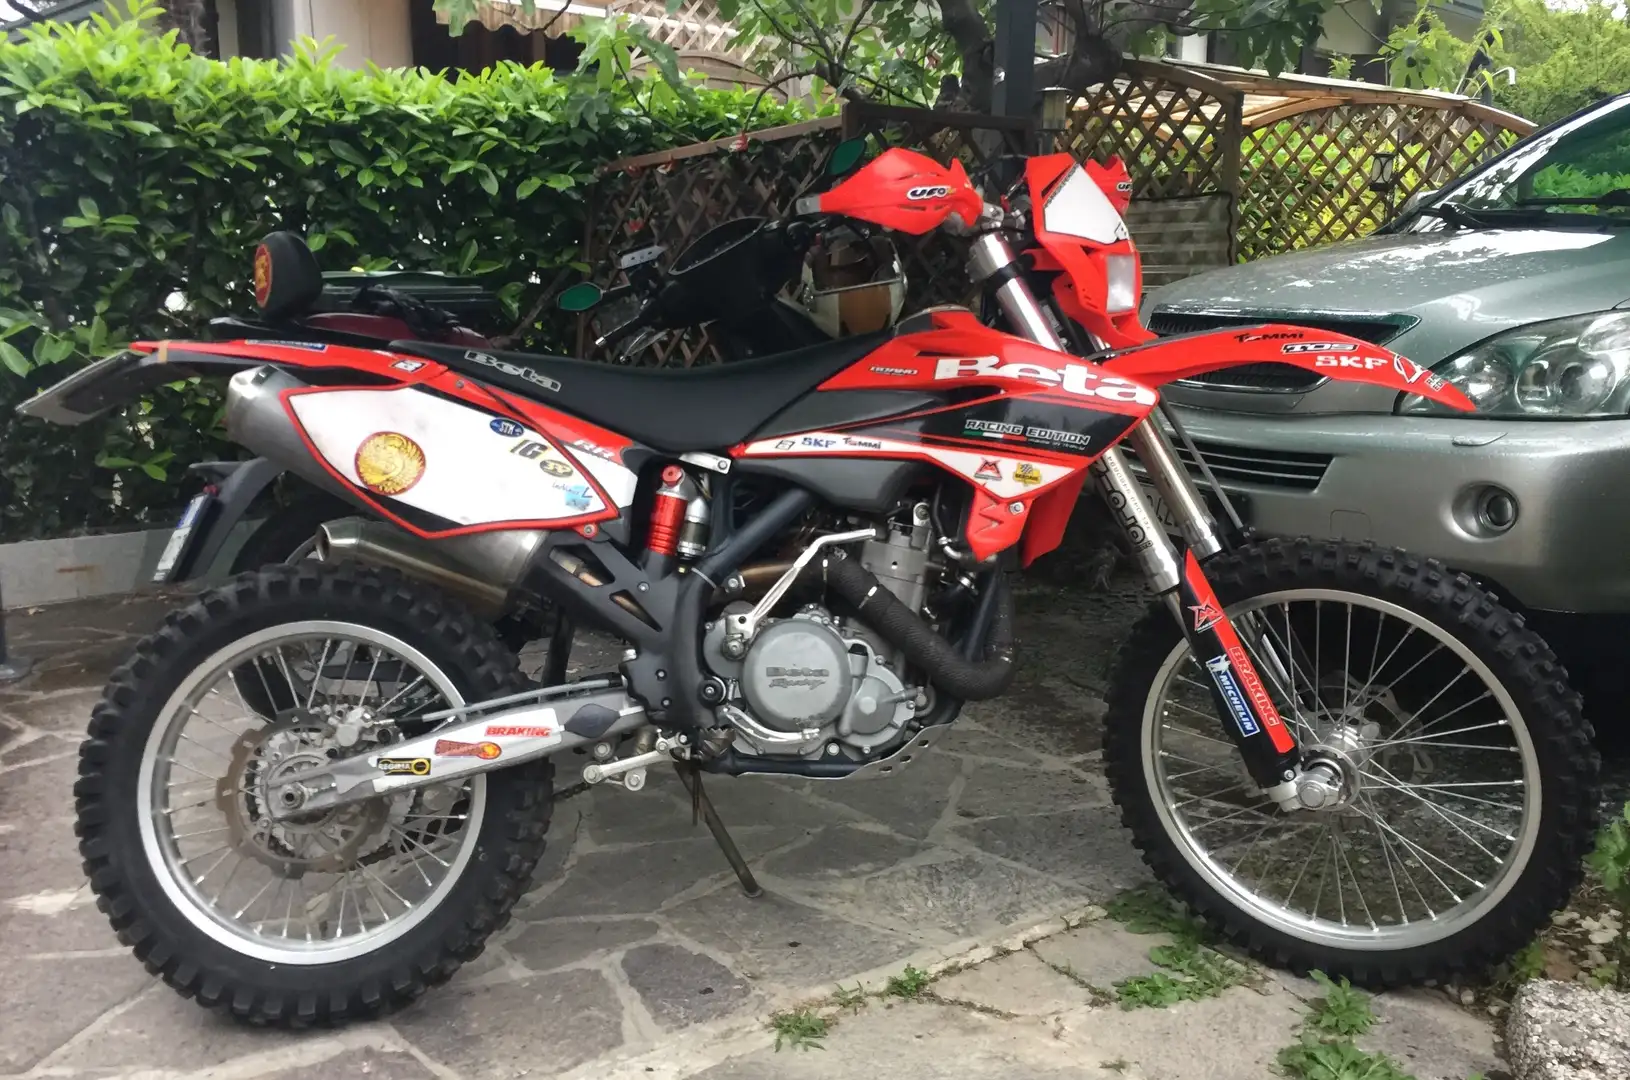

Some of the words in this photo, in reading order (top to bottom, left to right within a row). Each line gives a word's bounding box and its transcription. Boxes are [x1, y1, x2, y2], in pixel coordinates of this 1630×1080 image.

[907, 185, 949, 200] UFO
[1117, 182, 1133, 191] UF
[464, 350, 561, 392] Beta
[1316, 355, 1388, 369] SKF
[935, 355, 1157, 405] Beta
[802, 437, 836, 448] SKF
[965, 420, 1024, 435] RACING
[1026, 426, 1091, 446] EDITION
[1229, 646, 1280, 726] BRAKING
[1219, 674, 1254, 731] MICHELIN
[485, 726, 552, 737] BRAKING
